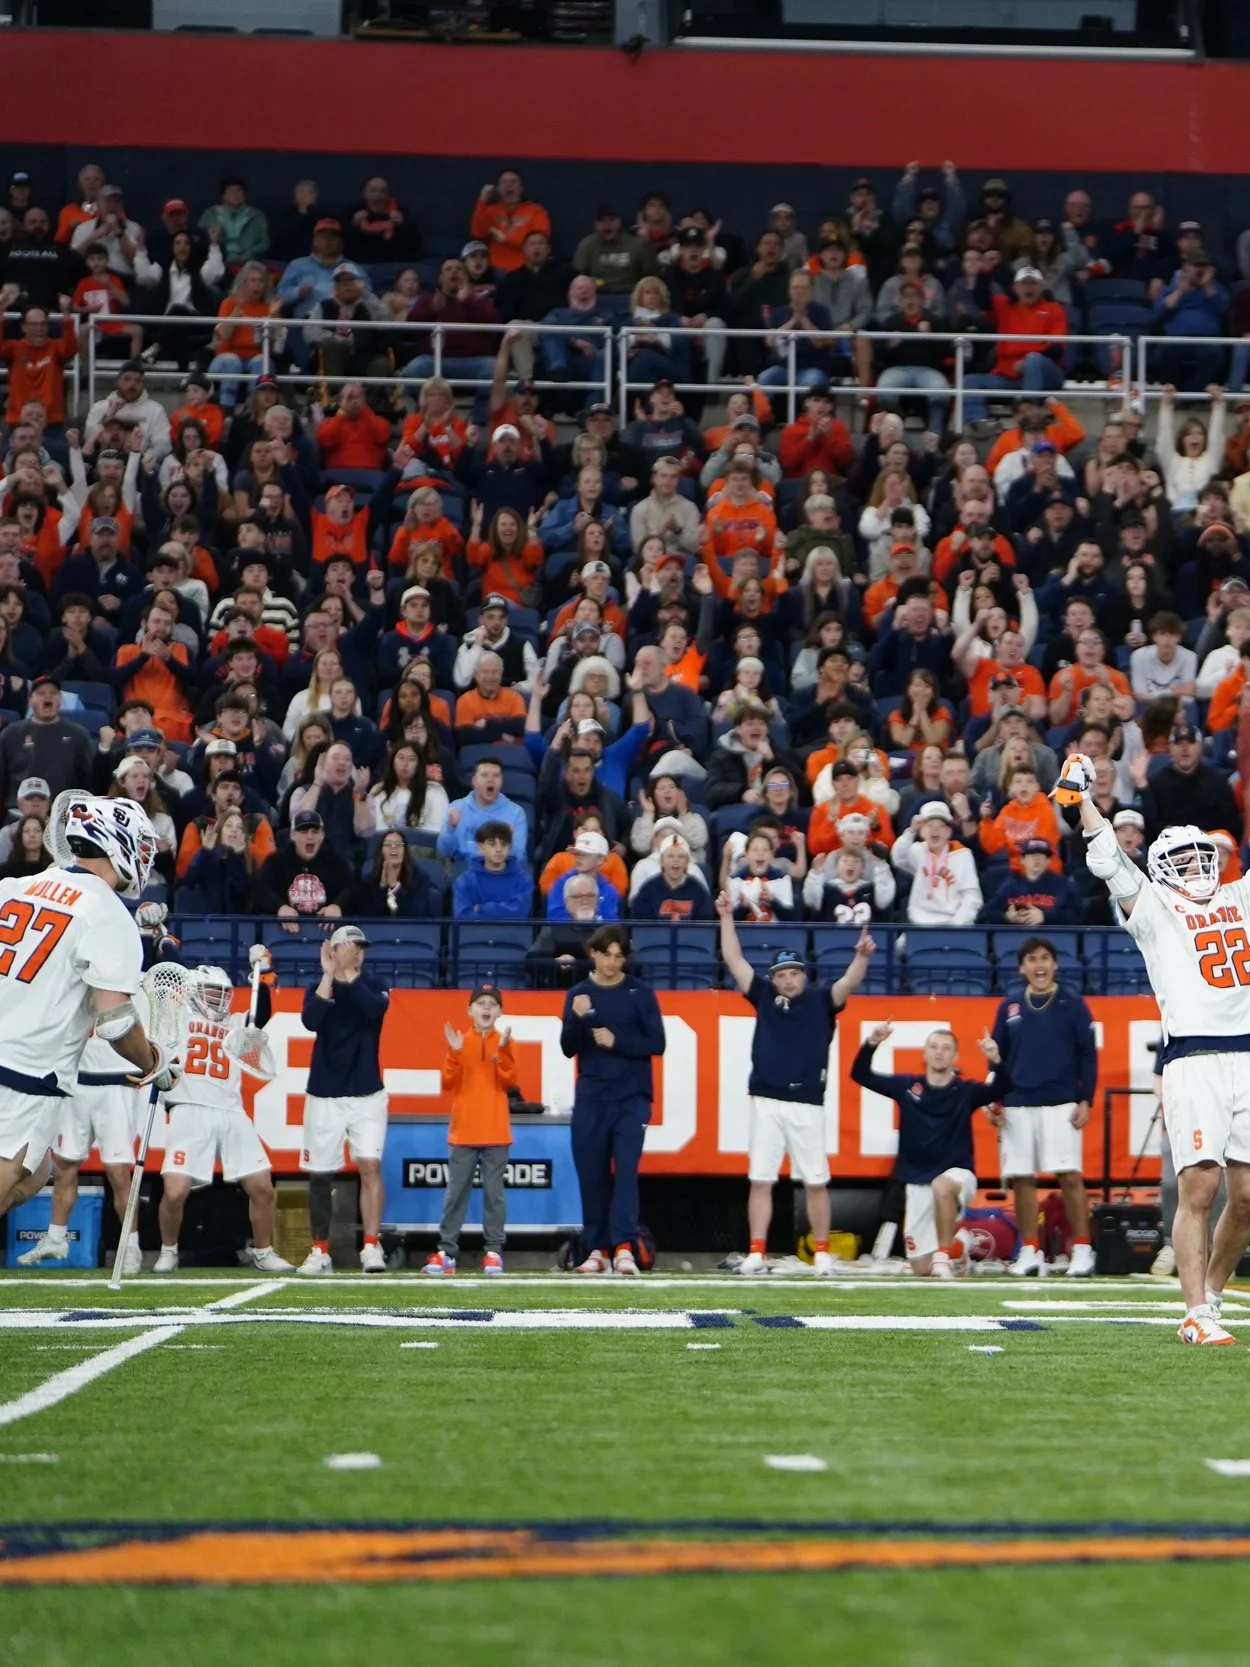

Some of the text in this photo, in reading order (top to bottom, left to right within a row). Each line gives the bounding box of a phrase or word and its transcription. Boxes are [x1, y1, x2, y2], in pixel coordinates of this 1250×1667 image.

[24, 880, 84, 907] MULLEN
[0, 898, 74, 985] 27
[185, 1036, 230, 1080] 29
[1192, 1129, 1203, 1151] S
[173, 1150, 186, 1166] S
[408, 1163, 550, 1184] POADE
[19, 1230, 78, 1241] POWDE
